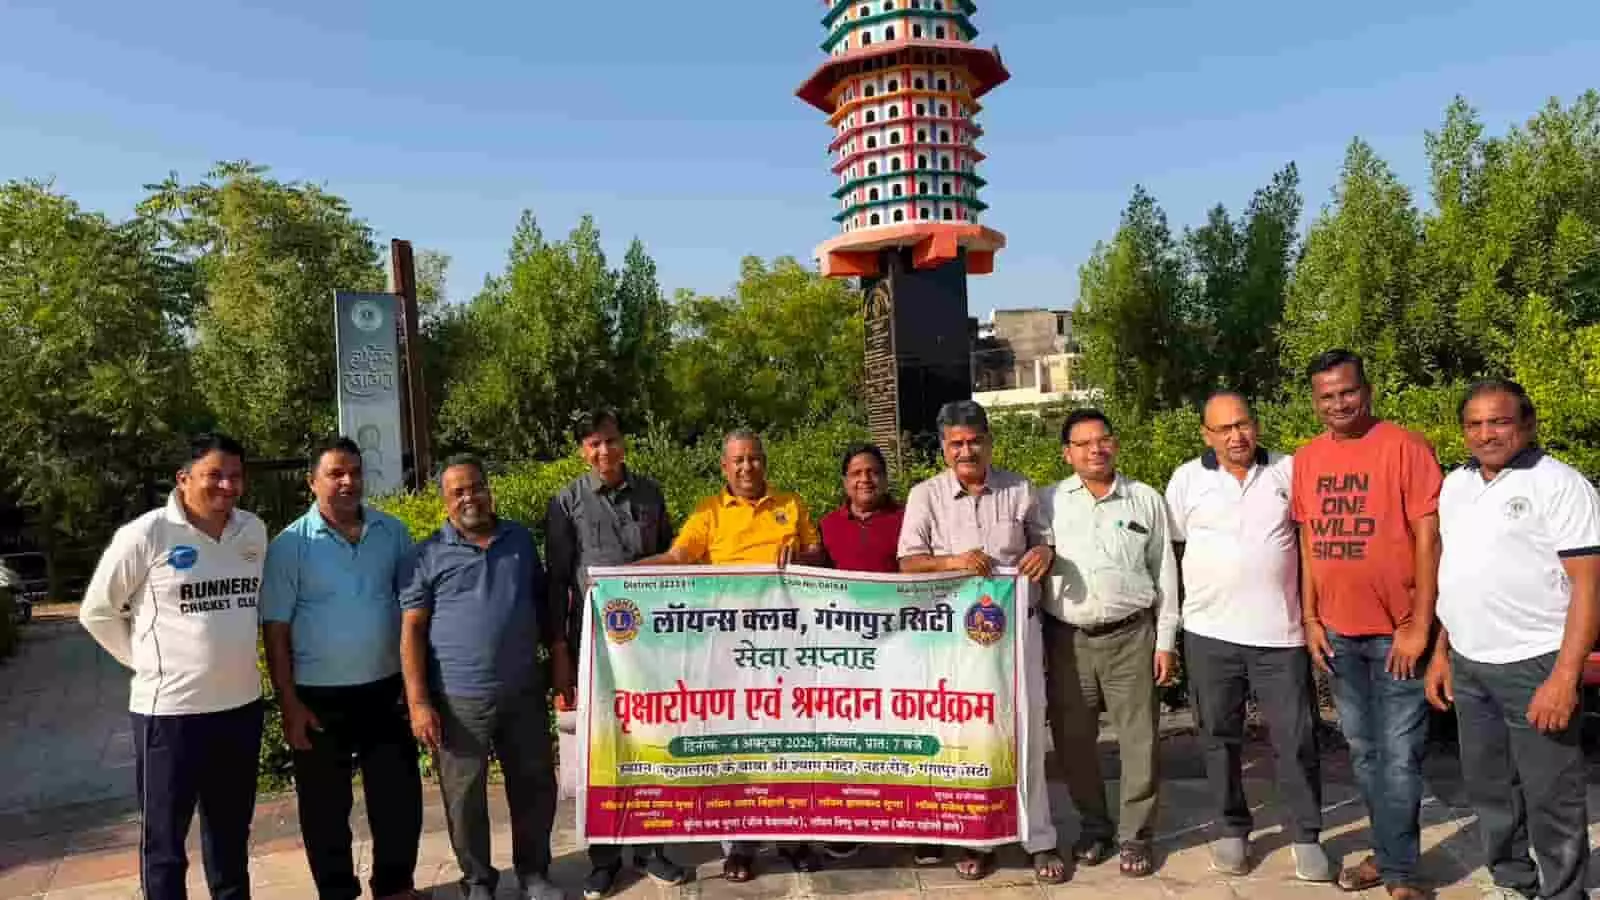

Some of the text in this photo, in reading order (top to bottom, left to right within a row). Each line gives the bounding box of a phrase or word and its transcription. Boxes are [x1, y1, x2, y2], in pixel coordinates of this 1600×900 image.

[1316, 474, 1369, 494] RUN
[1311, 518, 1376, 537] WILD
[1312, 540, 1367, 560] SIDE
[180, 577, 259, 600] RUNNERS
[180, 599, 231, 614] CRICKET
[652, 602, 738, 633] लॉयन्स
[742, 608, 807, 635] क्लब,
[814, 602, 896, 640] गंगापुर
[900, 603, 955, 633] सिटी
[733, 639, 876, 670] सेवा सप्ताह
[613, 675, 996, 734] वृक्षारोपण एवं श्रमदान कार्यक्रम
[682, 737, 719, 753] दिनांक
[721, 755, 736, 774] के
[919, 762, 957, 779] गंगापुर
[960, 762, 990, 777] सिटी
